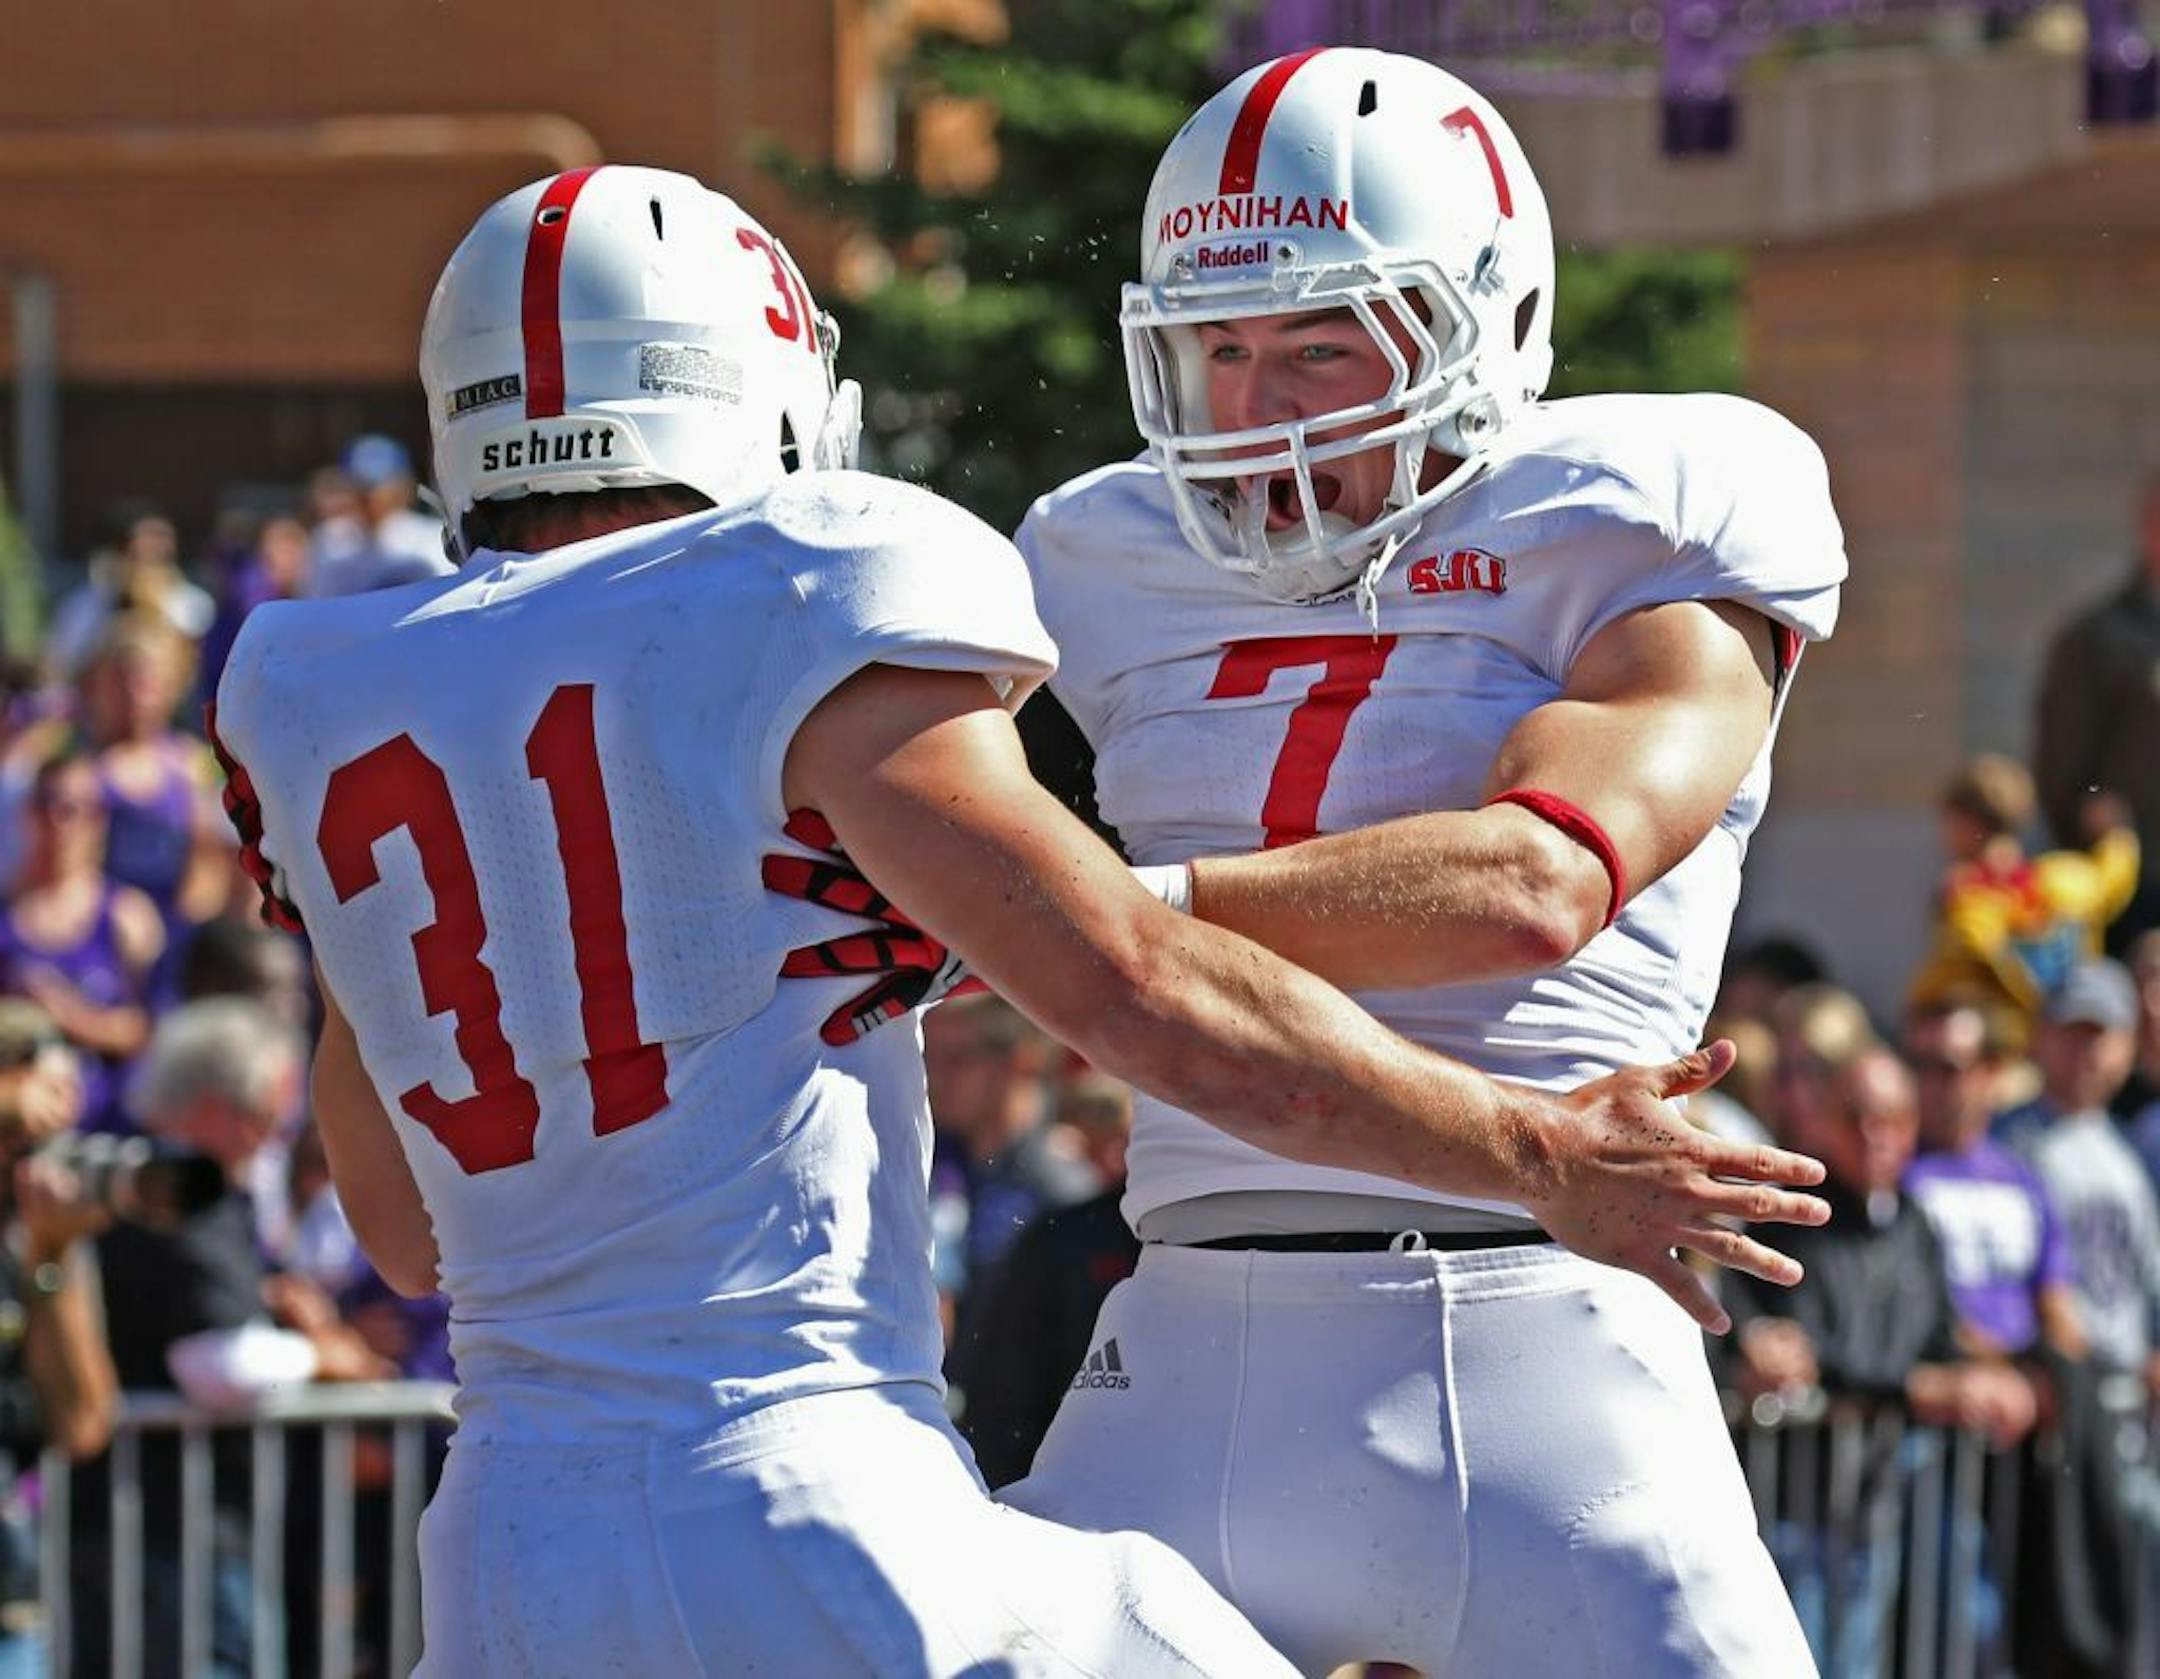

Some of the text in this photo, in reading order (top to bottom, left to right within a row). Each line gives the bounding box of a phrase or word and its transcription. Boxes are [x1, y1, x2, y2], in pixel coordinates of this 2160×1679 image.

[1439, 106, 1513, 219] 7
[1160, 196, 1348, 245] MOYNIHAN
[1198, 242, 1269, 269] Riddell
[736, 227, 816, 354] 31
[483, 428, 614, 471] schutt
[1408, 549, 1508, 595] SJU
[1204, 634, 1399, 851] 7
[316, 682, 671, 1175] 31
[1073, 1369, 1130, 1390] adidas
